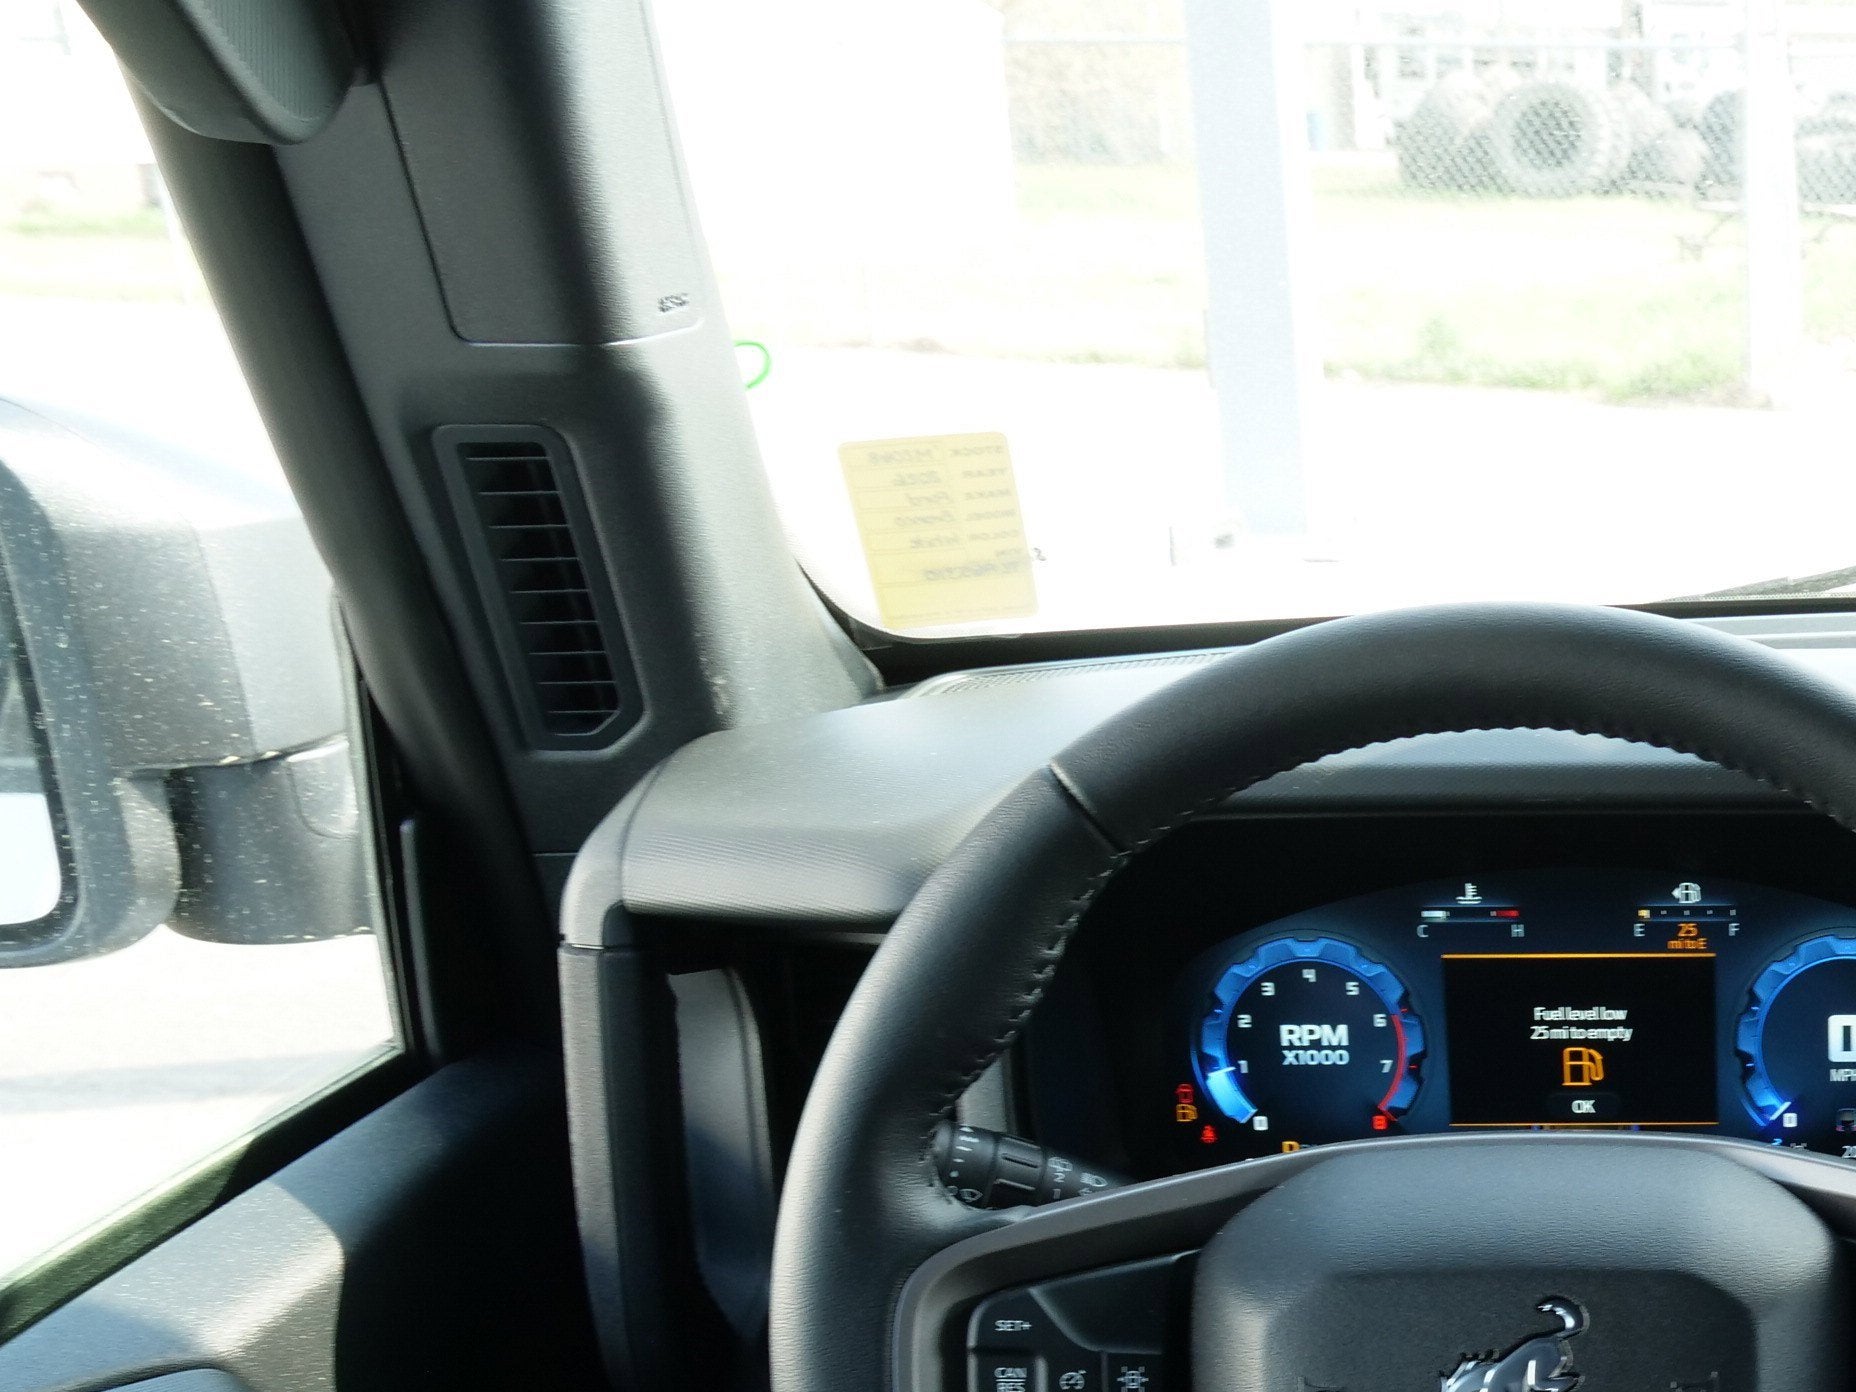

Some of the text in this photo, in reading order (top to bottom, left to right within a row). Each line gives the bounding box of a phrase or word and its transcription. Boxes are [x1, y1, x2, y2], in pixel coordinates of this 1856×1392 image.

[1416, 924, 1429, 938] C
[1511, 924, 1525, 938] H
[1634, 923, 1646, 938] E
[1677, 923, 1698, 937] 25
[1728, 923, 1740, 937] F
[1302, 969, 1316, 982] 4
[1261, 982, 1275, 996] 3
[1346, 982, 1360, 996] 5
[1533, 1006, 1628, 1021] Fuel level low
[1237, 1014, 1252, 1028] 2
[1373, 1014, 1387, 1028] 6
[1279, 1024, 1349, 1046] RPM
[1530, 1026, 1633, 1042] 25 mi to empty
[1282, 1050, 1349, 1065] X1000
[1237, 1060, 1248, 1073] 1
[1380, 1060, 1393, 1073] 7
[1571, 1099, 1596, 1114] OK
[1253, 1116, 1268, 1131] 0
[1372, 1115, 1388, 1130] 8
[1782, 1113, 1799, 1128] 0
